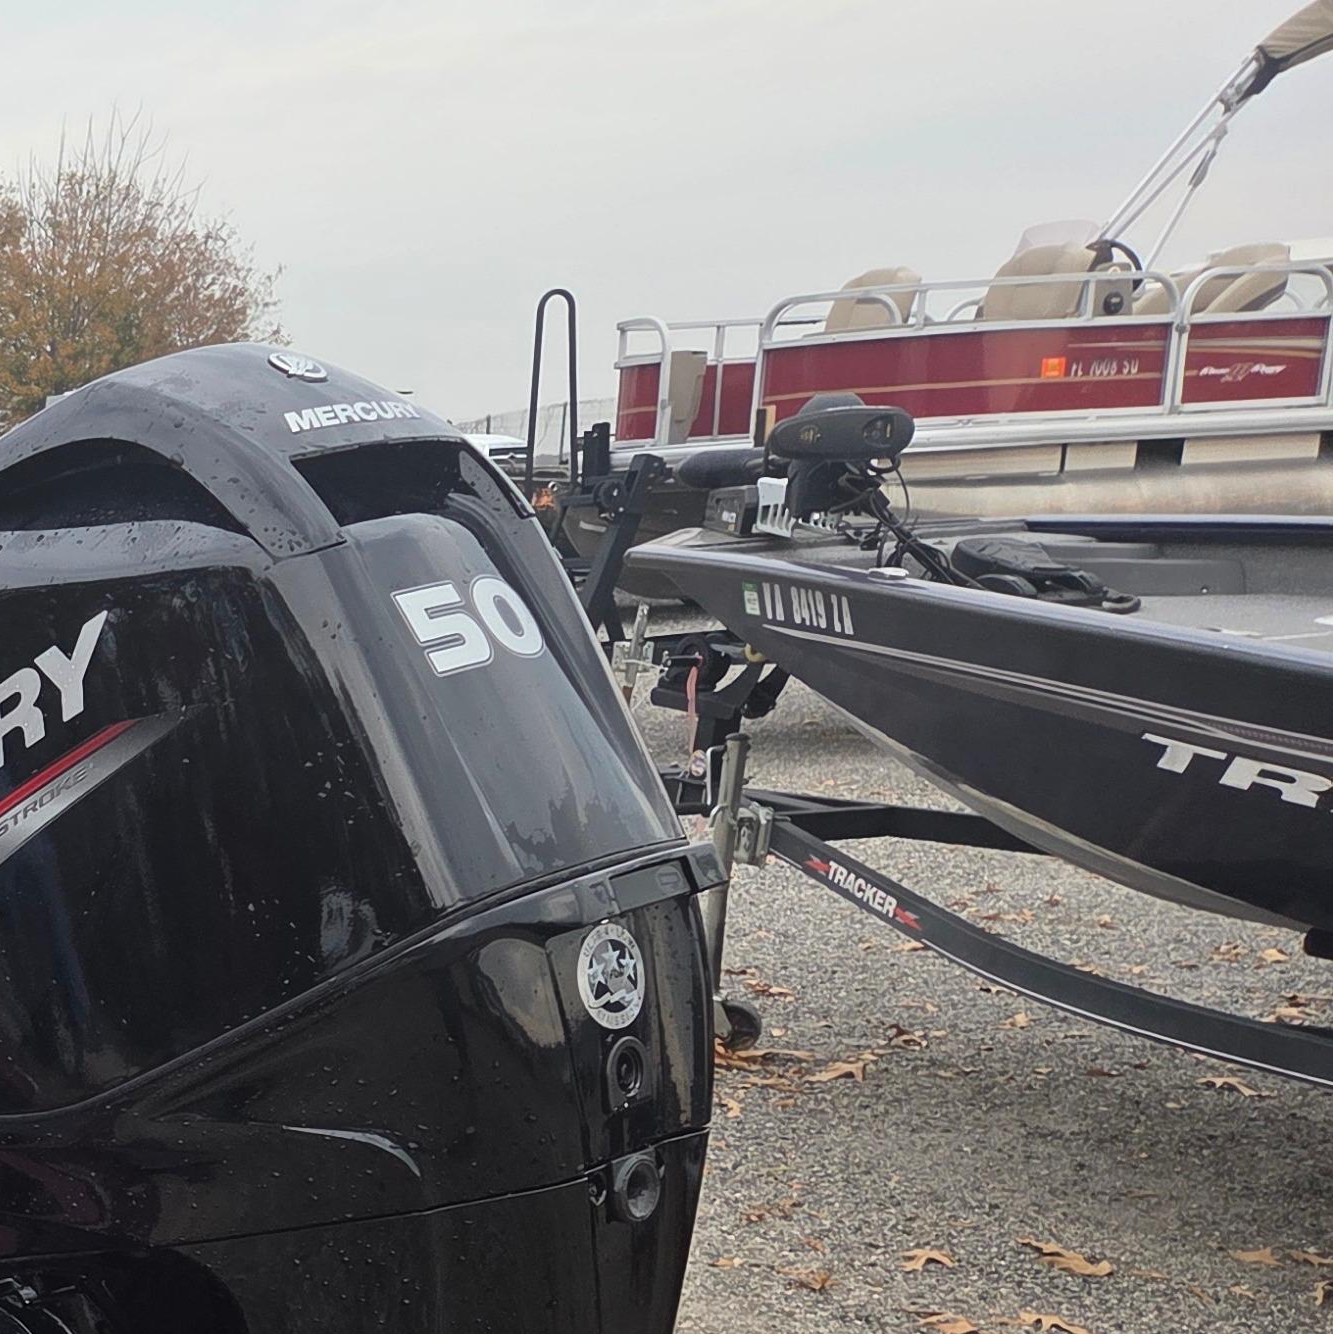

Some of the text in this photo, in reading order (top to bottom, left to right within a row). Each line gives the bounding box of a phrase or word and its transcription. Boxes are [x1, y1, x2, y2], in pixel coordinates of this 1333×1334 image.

[284, 401, 421, 433] MERCURY
[390, 574, 547, 677] 50
[762, 582, 785, 621] VA
[790, 586, 827, 629] 8419
[831, 593, 854, 635] ZA
[1141, 732, 1333, 813] TR
[827, 860, 898, 919] TRACKER
